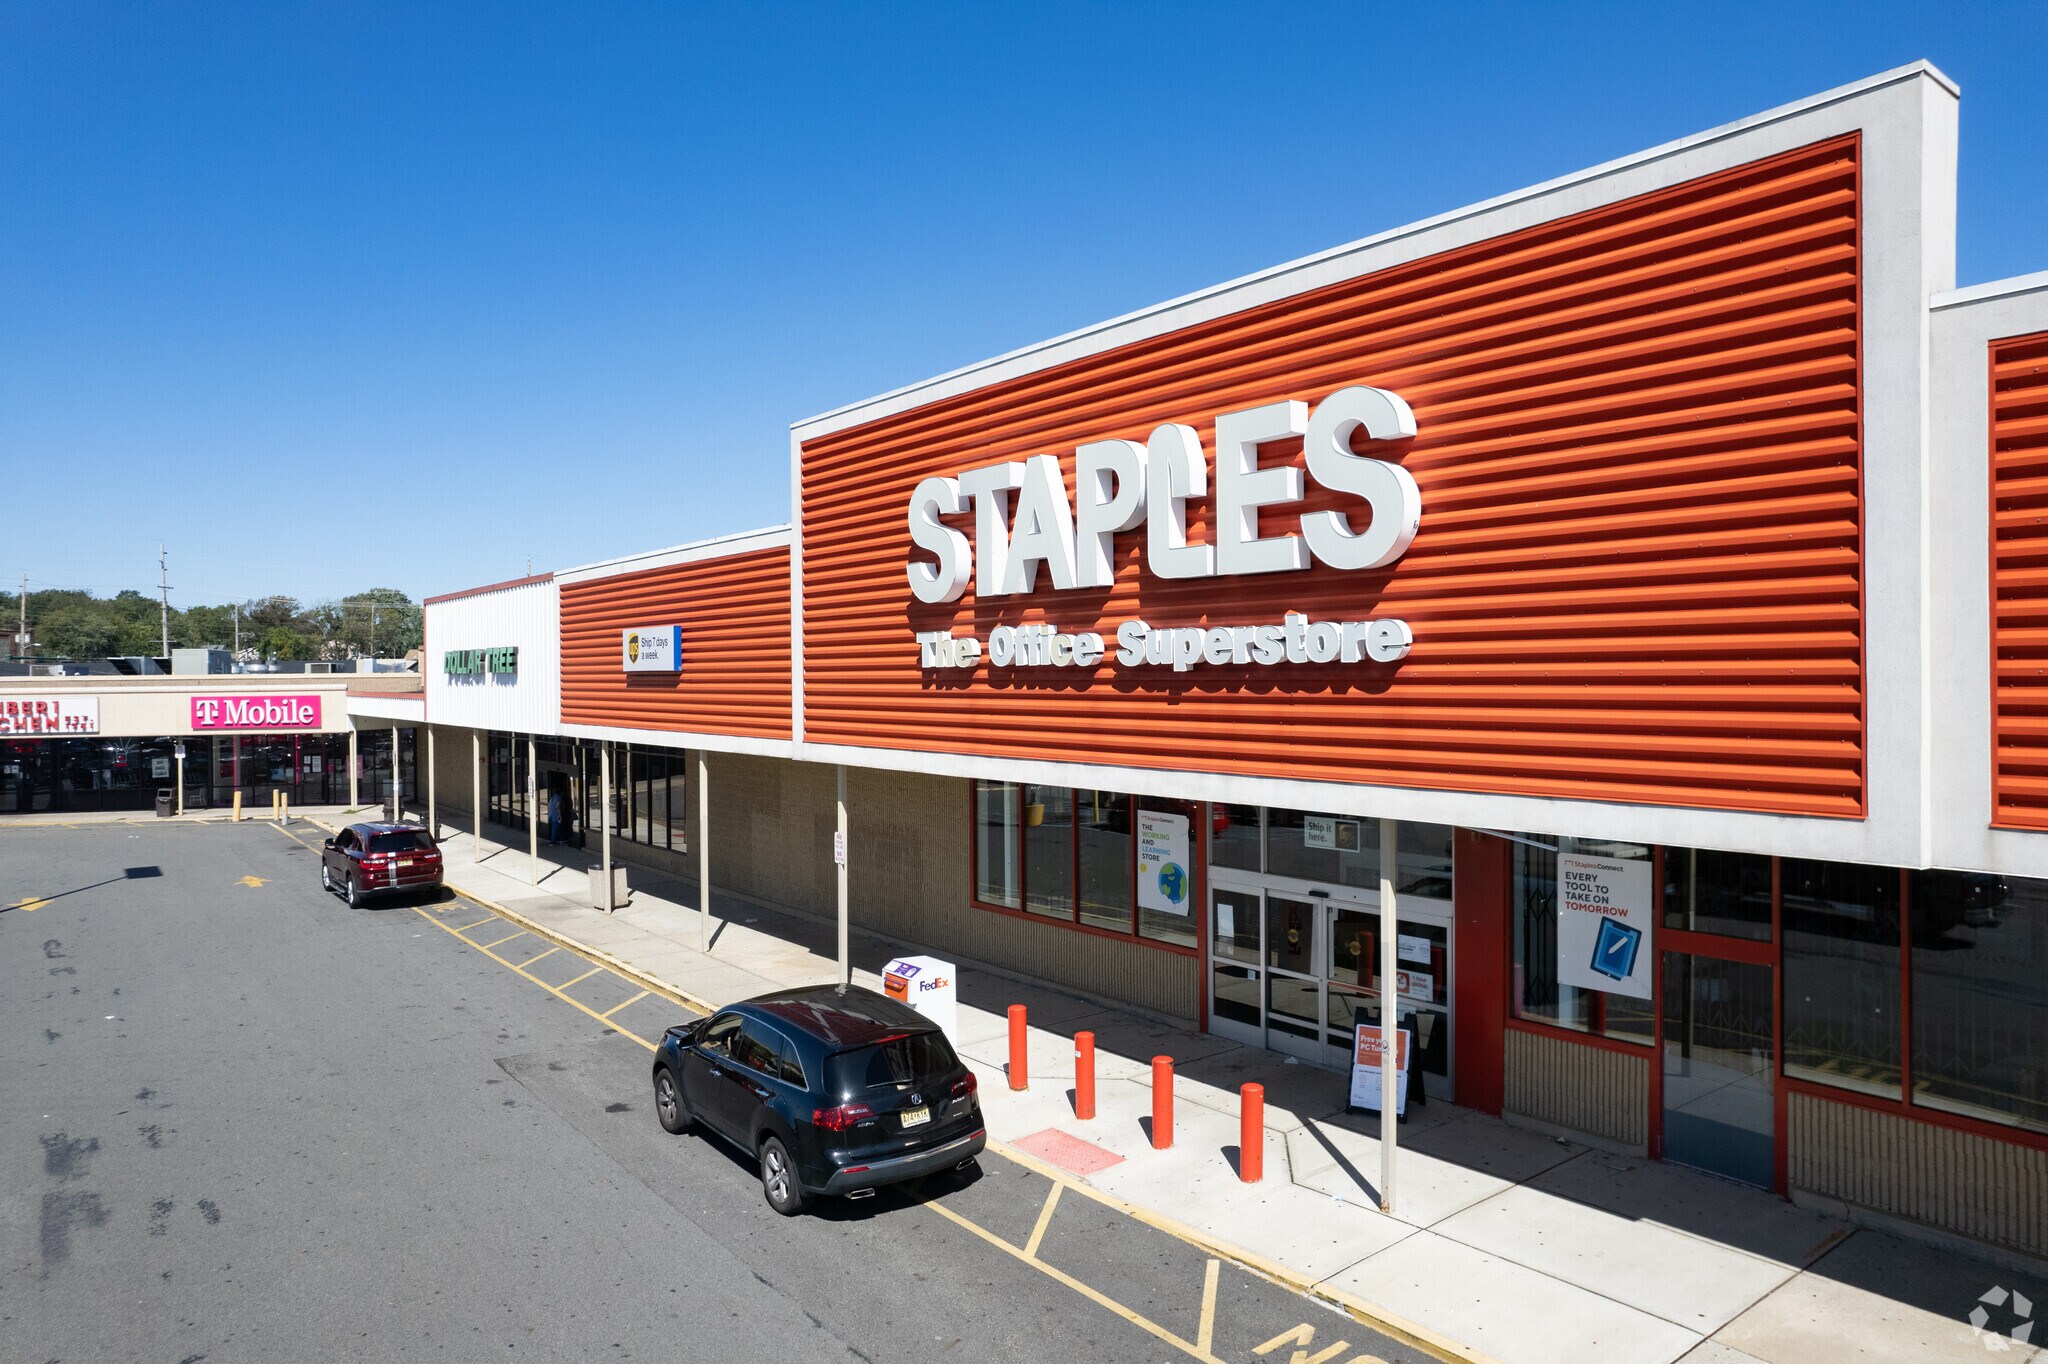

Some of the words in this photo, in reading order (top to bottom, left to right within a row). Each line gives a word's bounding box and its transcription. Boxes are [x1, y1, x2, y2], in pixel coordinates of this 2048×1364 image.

[906, 386, 1422, 604] STAPLES
[641, 637, 652, 649] Ship
[656, 637, 669, 648] days
[916, 631, 982, 668] The
[989, 625, 1104, 667] Office
[1115, 613, 1413, 673] Superstore
[444, 649, 485, 674] DOLLAR
[486, 646, 518, 673] TREE
[0, 701, 48, 715] BER
[223, 698, 314, 725] Mobile
[1141, 823, 1153, 831] THE
[1308, 821, 1325, 834] Ship
[1326, 823, 1332, 833] it
[1141, 831, 1170, 841] WORKING
[1141, 838, 1155, 846] AND
[1308, 832, 1327, 842] here.
[1141, 845, 1171, 856] LEARNING
[1141, 852, 1160, 862] STORE
[1565, 871, 1599, 883] EVERY
[1565, 881, 1593, 892] TOOL
[1594, 885, 1609, 894] TO
[1565, 891, 1592, 902] TAKE
[1593, 895, 1609, 905] ON
[1565, 901, 1629, 917] TOMORROW
[919, 977, 949, 992] FedEx
[1360, 1043, 1370, 1051] PC
